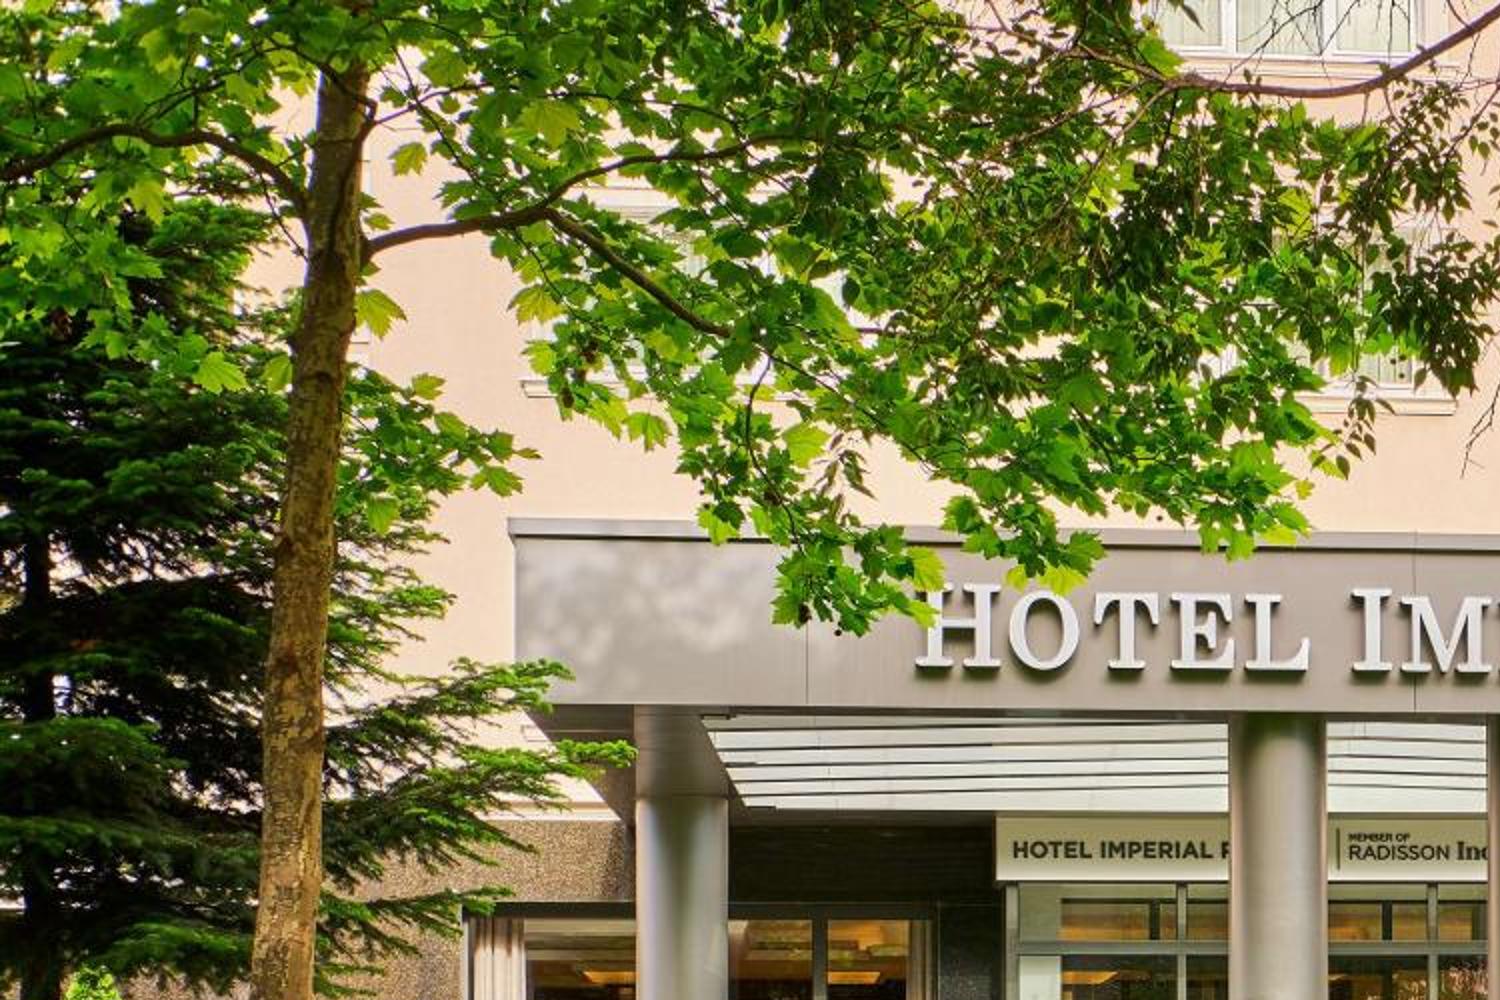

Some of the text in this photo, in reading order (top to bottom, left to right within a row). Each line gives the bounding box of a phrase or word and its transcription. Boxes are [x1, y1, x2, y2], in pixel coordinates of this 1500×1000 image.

[915, 583, 1310, 671] HOTEL
[1348, 832, 1410, 842] MEMBER OF
[1013, 841, 1092, 859] HOTEL
[1101, 841, 1213, 859] IMPERIAL
[1349, 844, 1450, 861] RADISSON
